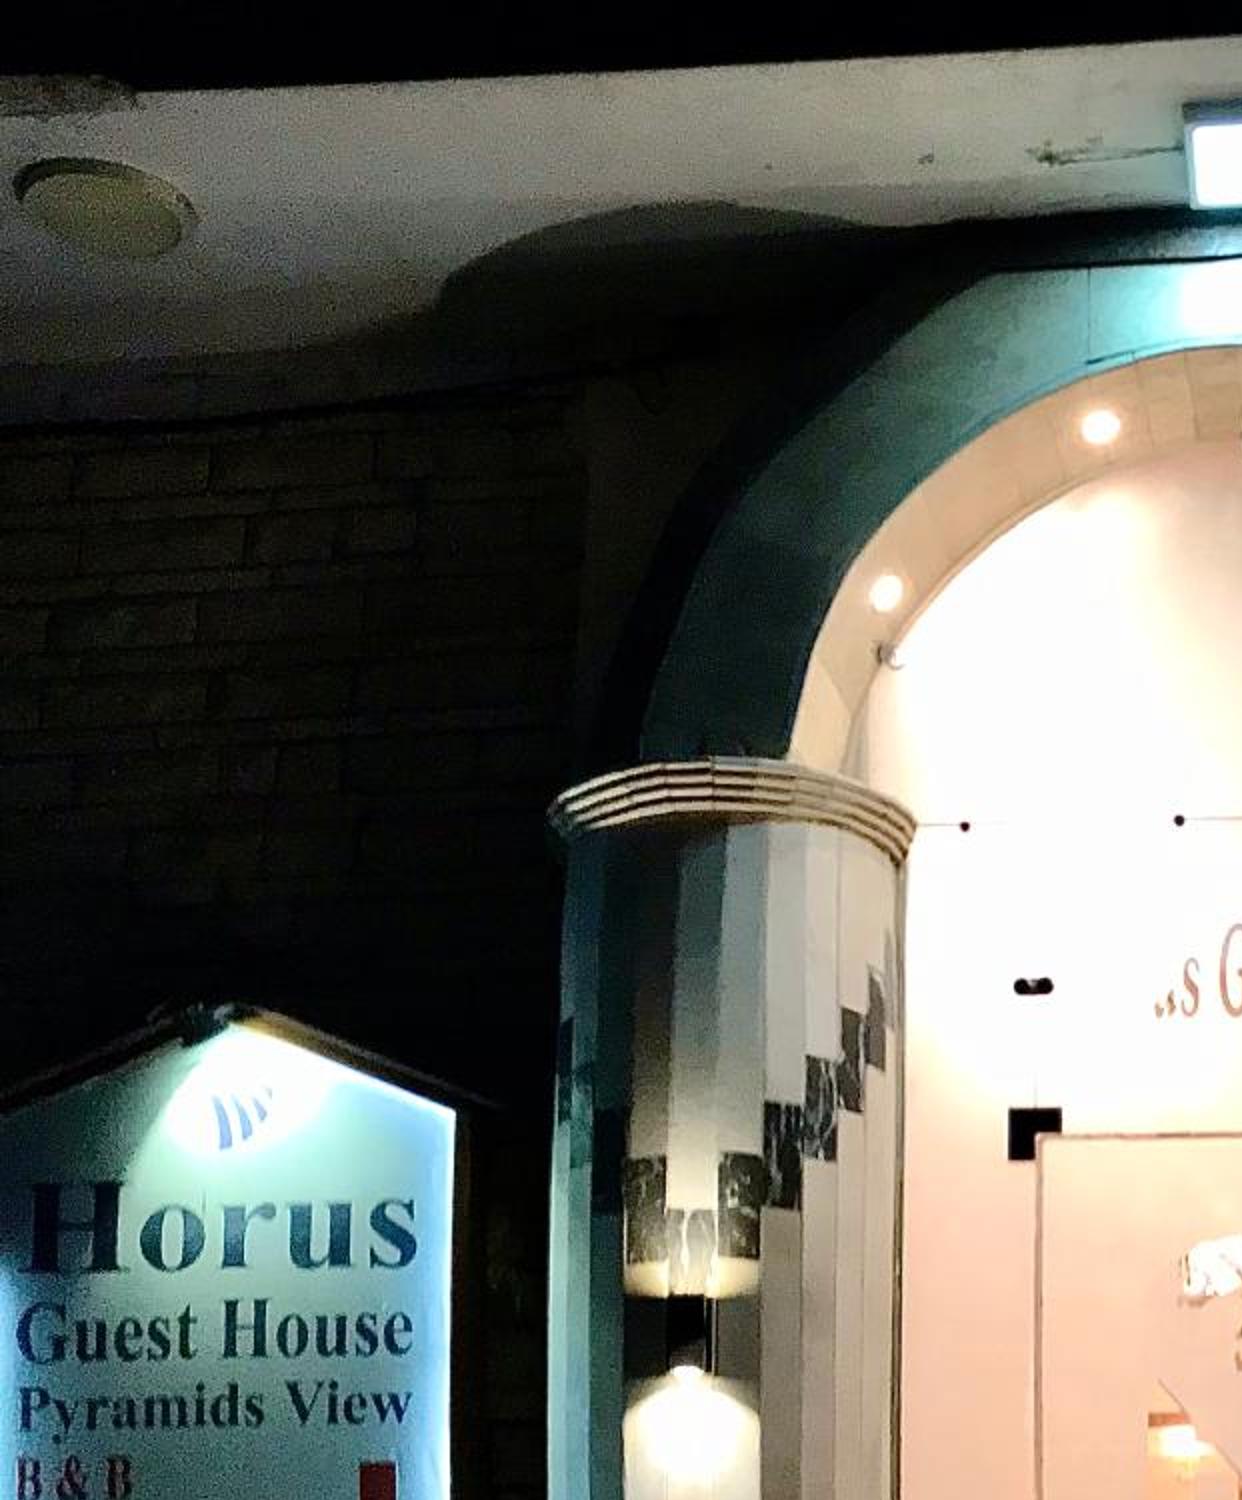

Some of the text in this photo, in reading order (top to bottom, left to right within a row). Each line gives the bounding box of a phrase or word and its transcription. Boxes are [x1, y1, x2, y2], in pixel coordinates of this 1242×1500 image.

[18, 1180, 418, 1273] Horus
[16, 1299, 414, 1364] Guest House
[19, 1380, 413, 1444] Pyramids View
